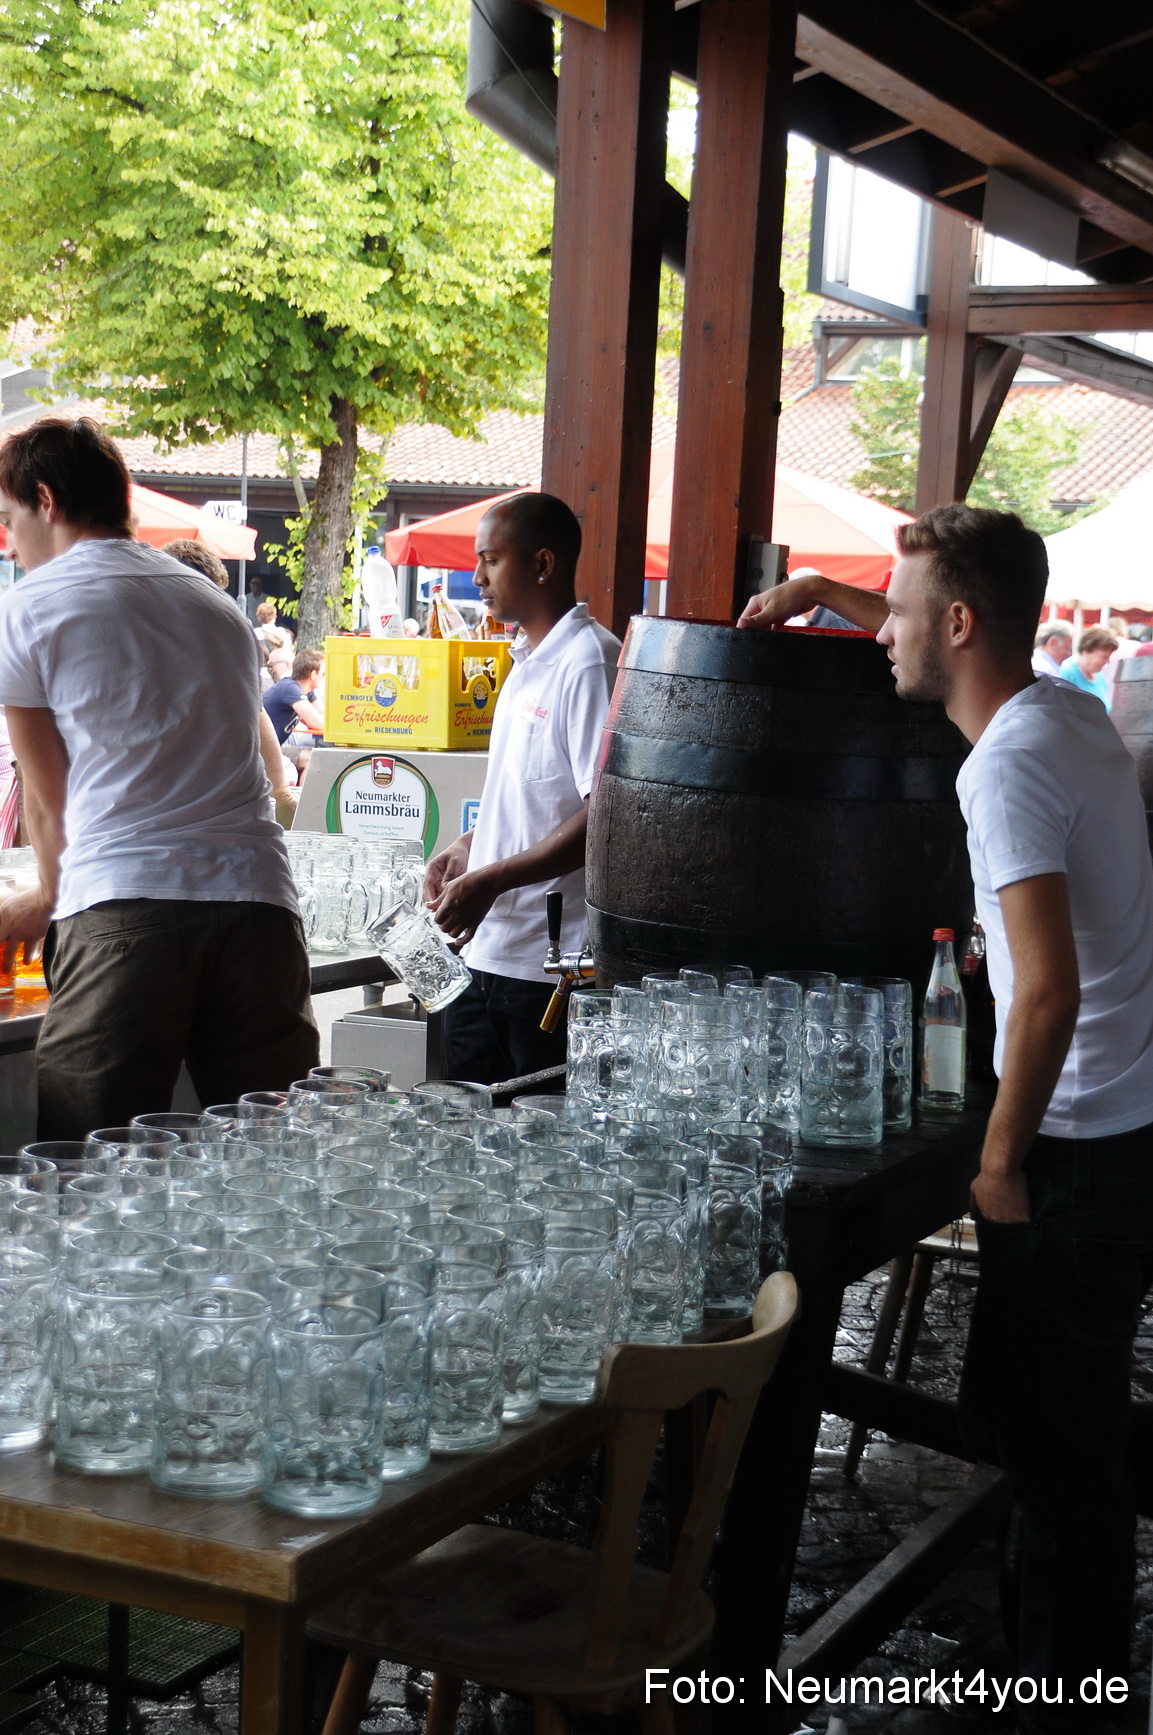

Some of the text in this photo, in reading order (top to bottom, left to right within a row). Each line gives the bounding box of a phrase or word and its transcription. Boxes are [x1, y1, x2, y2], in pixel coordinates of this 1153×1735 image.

[213, 504, 236, 521] WC
[343, 704, 429, 728] Erfrischungen
[374, 726, 413, 735] RIEDENBURG
[355, 790, 411, 803] Neumarkter
[345, 801, 420, 818] Lammsbräu
